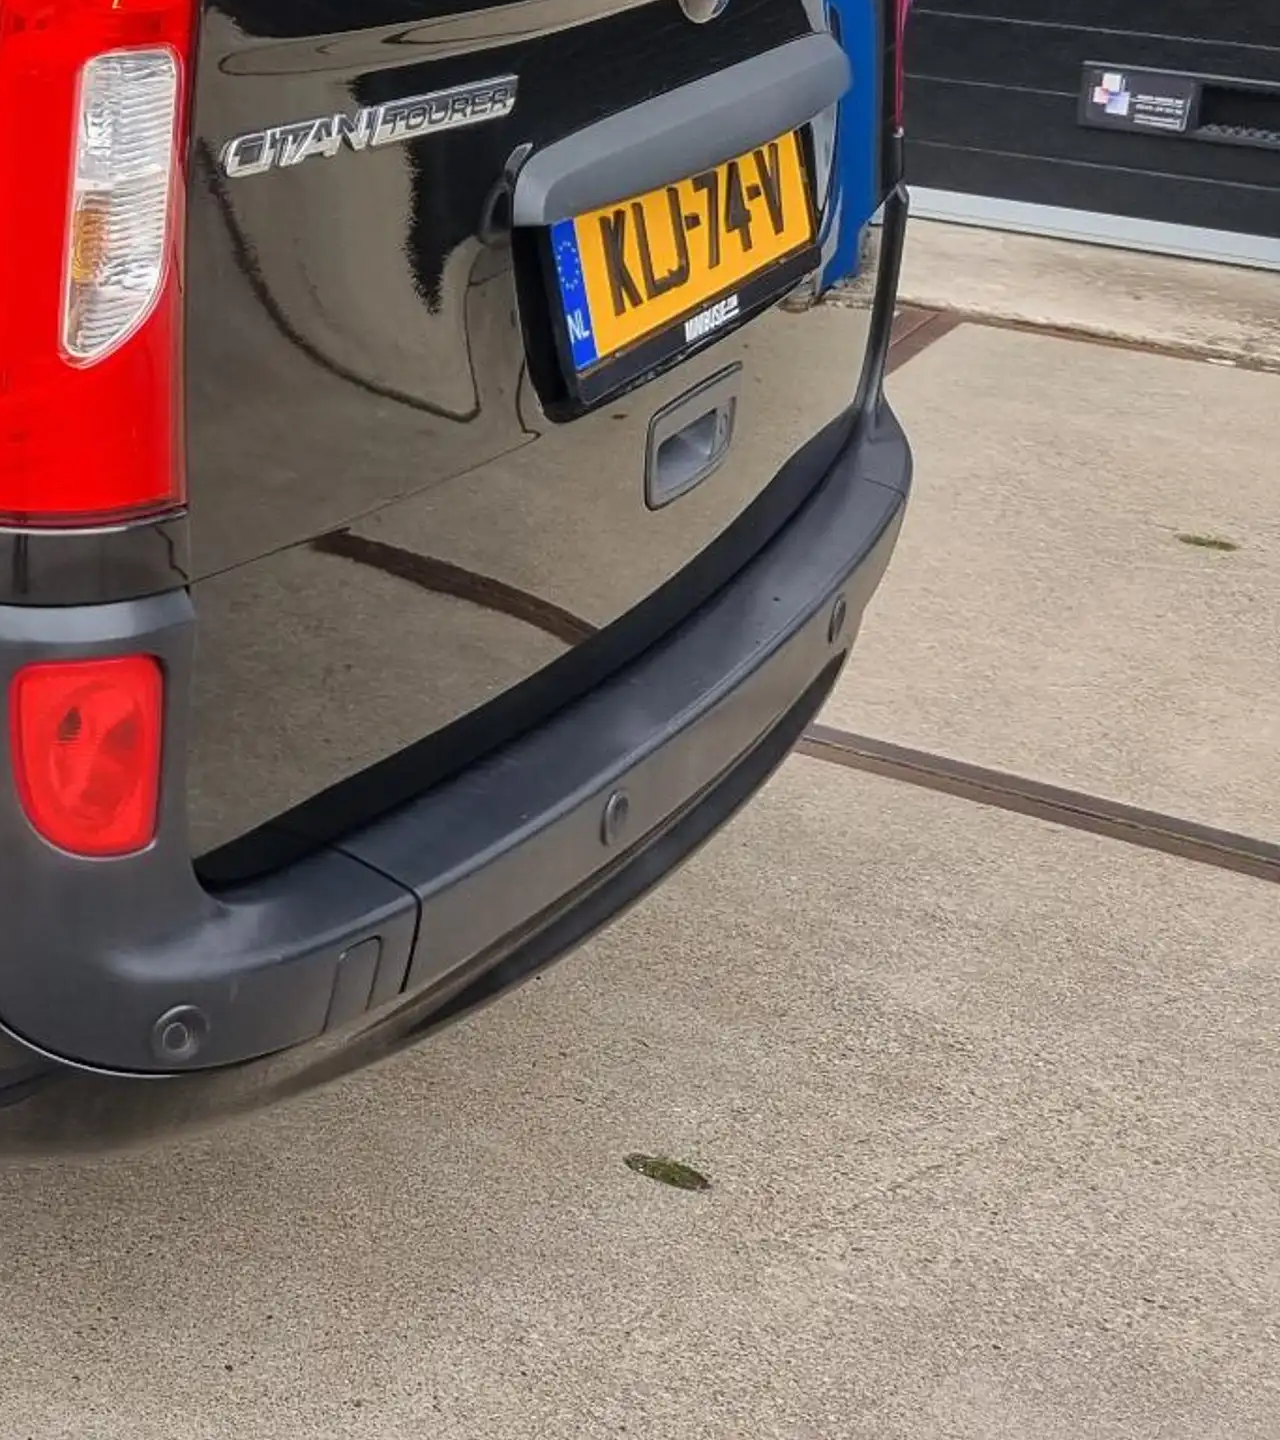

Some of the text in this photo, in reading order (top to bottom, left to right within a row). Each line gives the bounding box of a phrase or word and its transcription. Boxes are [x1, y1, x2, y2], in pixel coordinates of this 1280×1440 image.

[220, 87, 510, 178] CITAN TOURER
[598, 142, 784, 317] KLJ-74-V
[567, 309, 590, 344] NL
